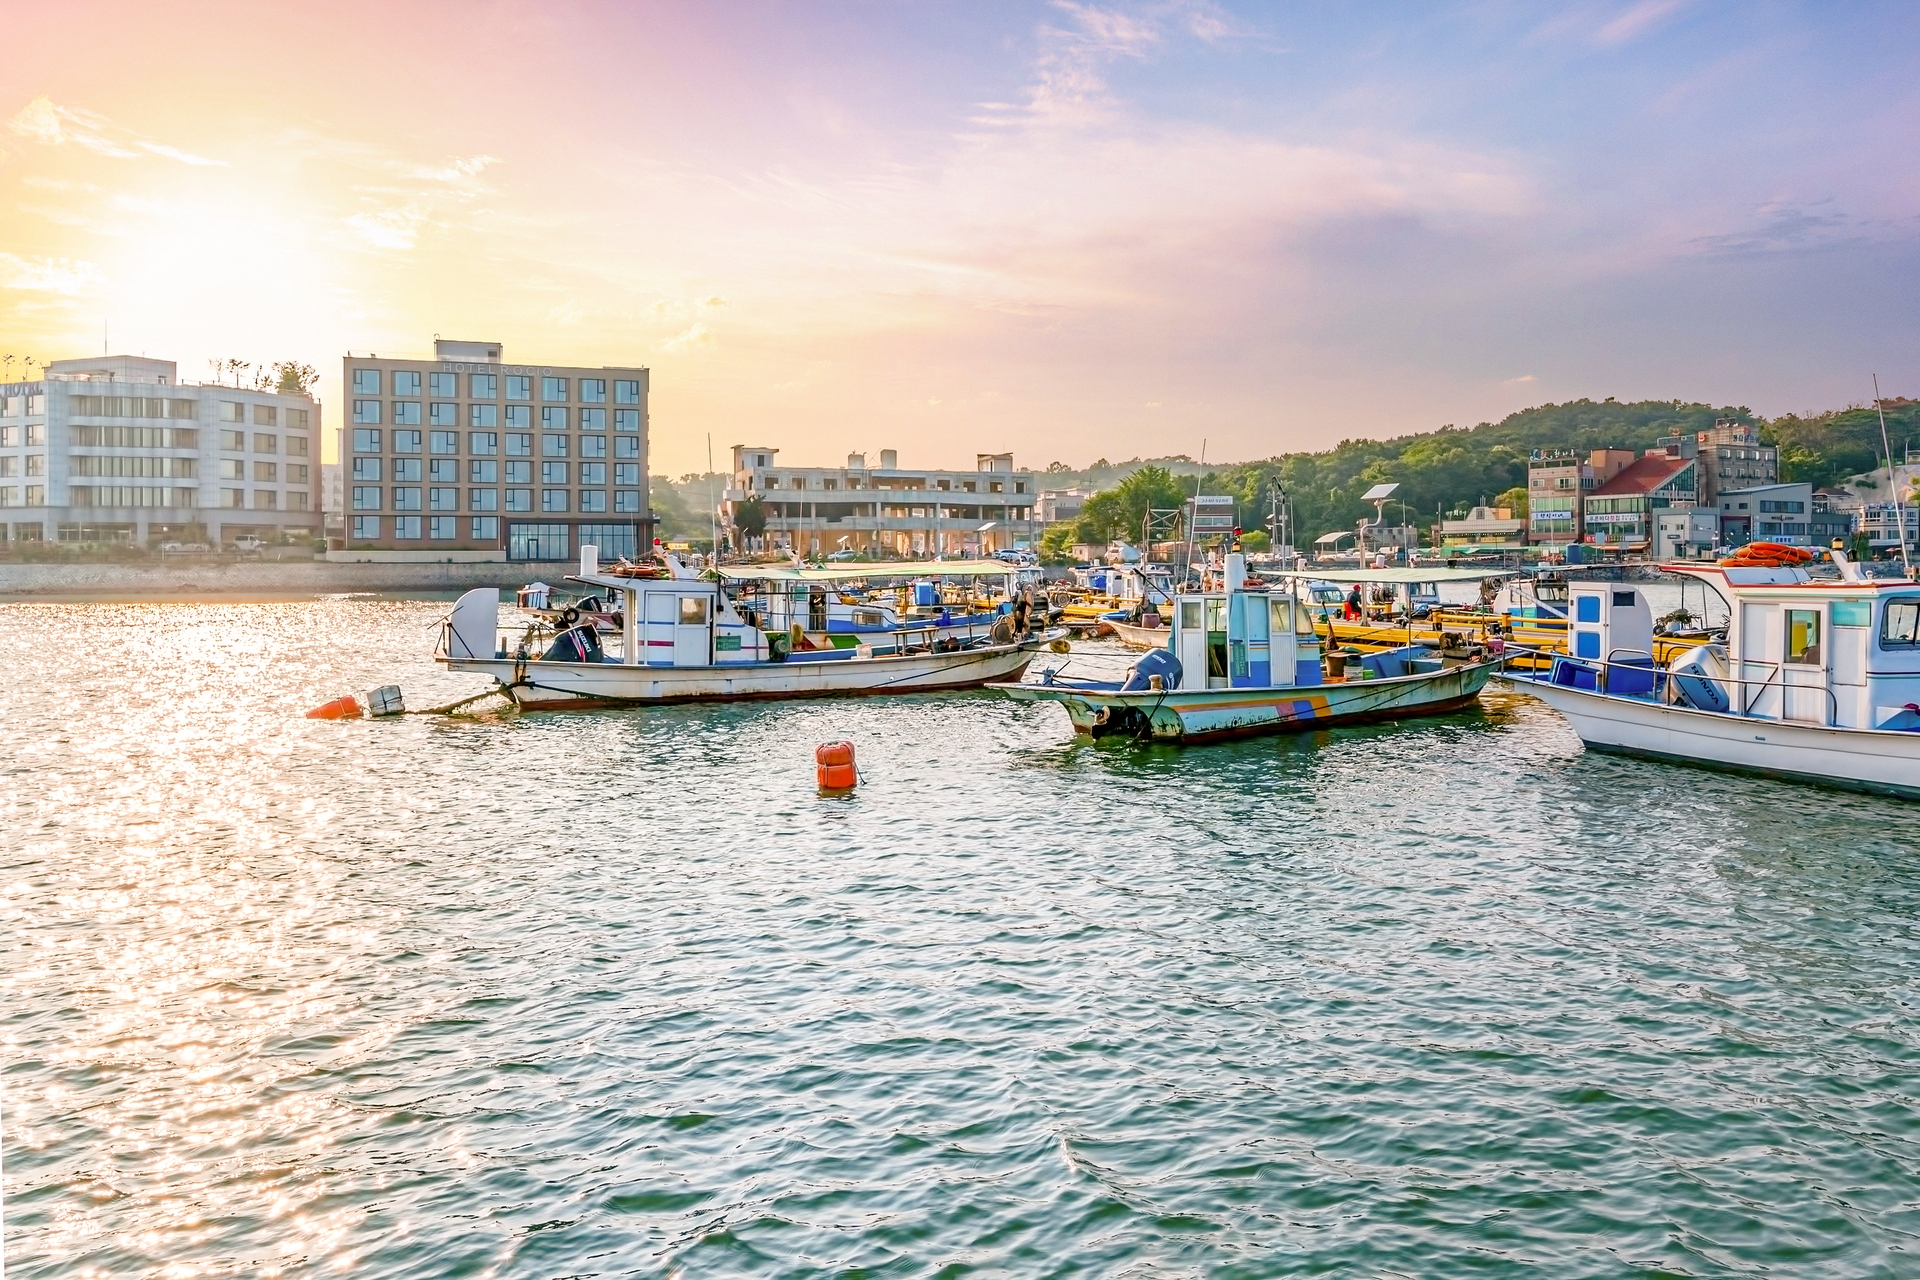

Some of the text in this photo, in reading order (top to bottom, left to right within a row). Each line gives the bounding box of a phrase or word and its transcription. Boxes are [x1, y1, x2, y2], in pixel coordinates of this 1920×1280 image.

[443, 363, 553, 376] HOTEL ROCIO
[3, 381, 43, 397] HOTEL
[577, 630, 592, 653] SUZUKI
[1691, 665, 1719, 706] HONDA
